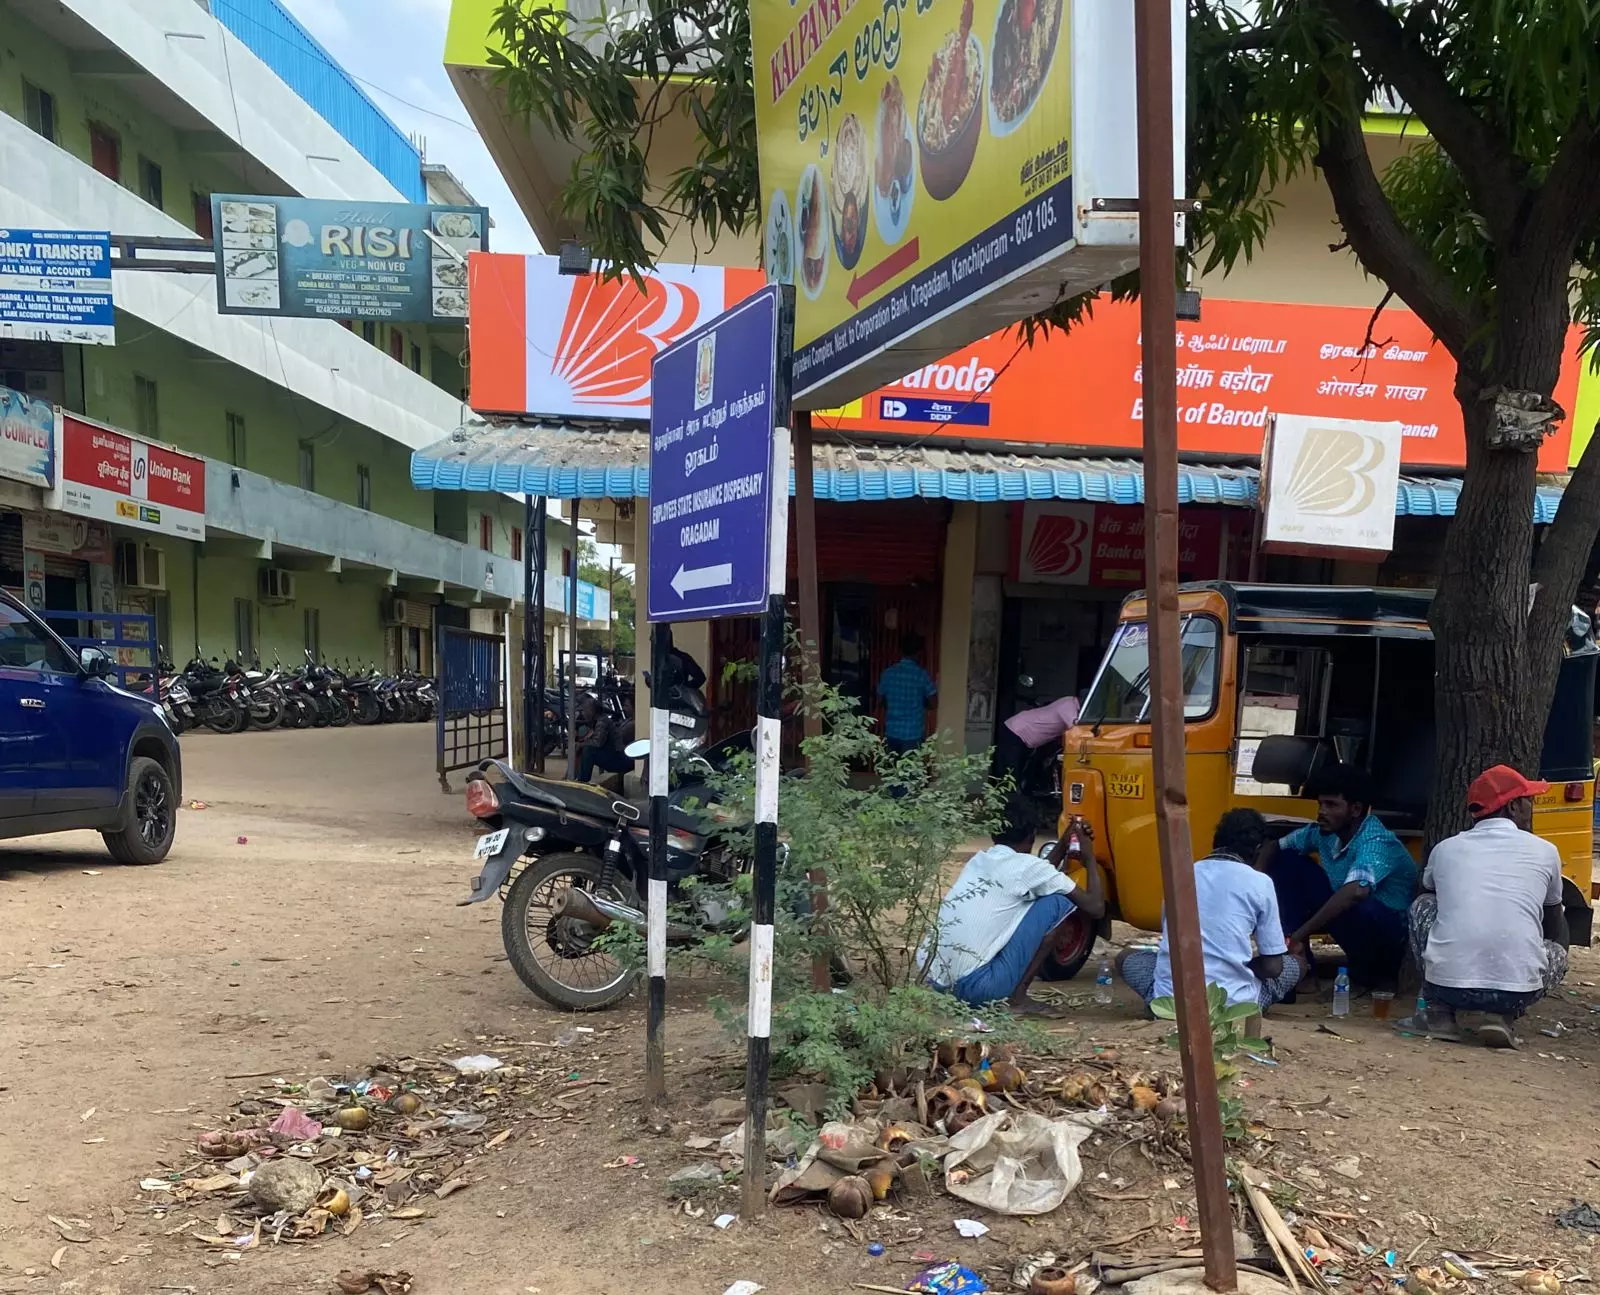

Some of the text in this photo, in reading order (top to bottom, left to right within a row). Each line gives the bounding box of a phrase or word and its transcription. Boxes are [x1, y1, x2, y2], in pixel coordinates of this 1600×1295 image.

[321, 224, 412, 260] RISI
[33, 243, 103, 260] TRANSFER
[2, 265, 91, 276] ALL BANK ACCOUNTS
[340, 260, 406, 272] VEG NON VEG
[849, 326, 855, 342] to
[855, 304, 890, 341] Corporation
[911, 270, 950, 307] Oragadam,
[952, 233, 1008, 285] Kanchipuram
[1016, 210, 1033, 245] 602
[1036, 197, 1057, 233] 105.
[24, 294, 35, 302] ALL
[1232, 336, 1288, 354] பரோடா
[888, 357, 996, 392] aroda
[1385, 384, 1428, 401] शाखा
[1185, 403, 1207, 425] of
[1207, 402, 1269, 428] Barod
[150, 460, 192, 486] Union Bank
[652, 471, 764, 525] EMPLOYEES STATE INSURANCE DISPENSARY
[680, 518, 720, 548] ORAGADAM
[1096, 544, 1130, 559] Bank
[1109, 783, 1140, 796] 3391
